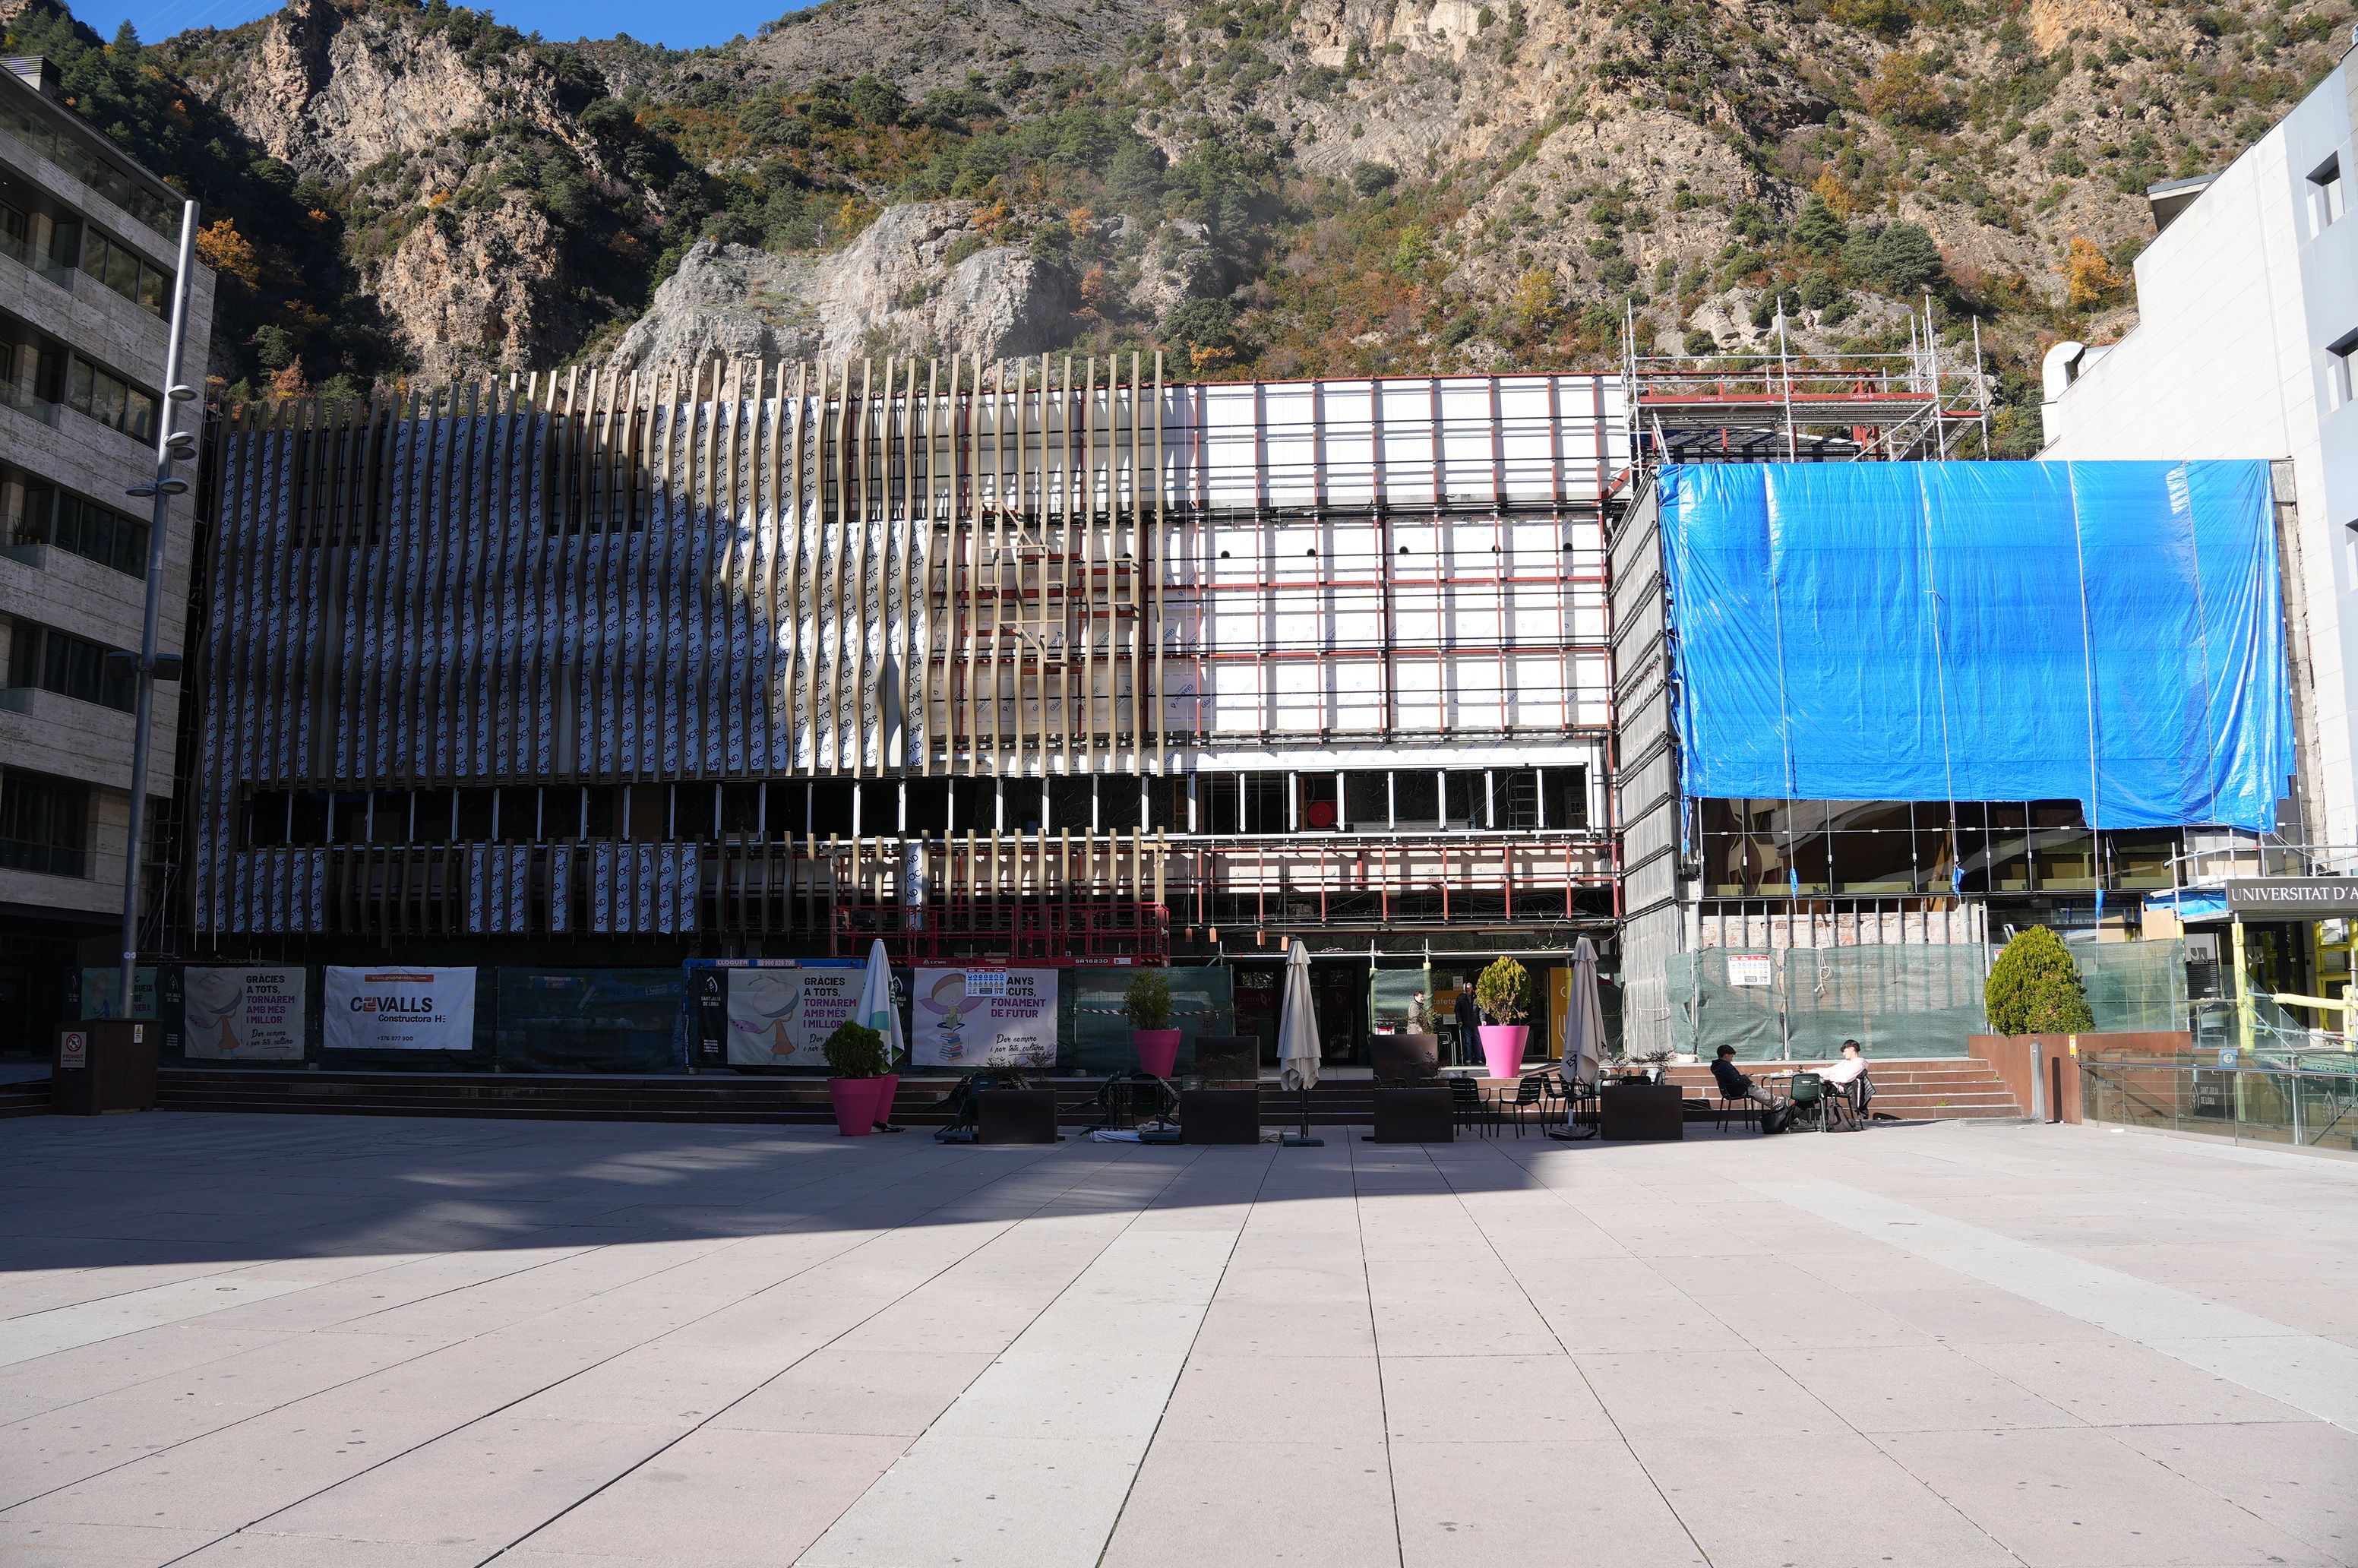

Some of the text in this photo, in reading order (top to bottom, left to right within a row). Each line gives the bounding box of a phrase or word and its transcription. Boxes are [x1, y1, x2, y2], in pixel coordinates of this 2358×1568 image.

[2231, 887, 2329, 902] UNIVERSITAT
[246, 973, 285, 983] GRÀCIES
[804, 975, 846, 986] GRÀCIES
[1007, 977, 1034, 985] ANYS
[255, 986, 280, 994] TOTS,
[814, 988, 840, 997] TOTS,
[246, 995, 295, 1004] TORNAREM
[804, 998, 857, 1007] TORNAREM
[991, 998, 1046, 1007] FONAMENT
[267, 1004, 286, 1014] MÉS
[804, 1007, 846, 1017] AMB MÉS
[991, 1009, 1038, 1018] DE FUTUR
[246, 1016, 249, 1024] I
[378, 1014, 431, 1023] Constructora
[803, 1020, 842, 1029] I MILLOR
